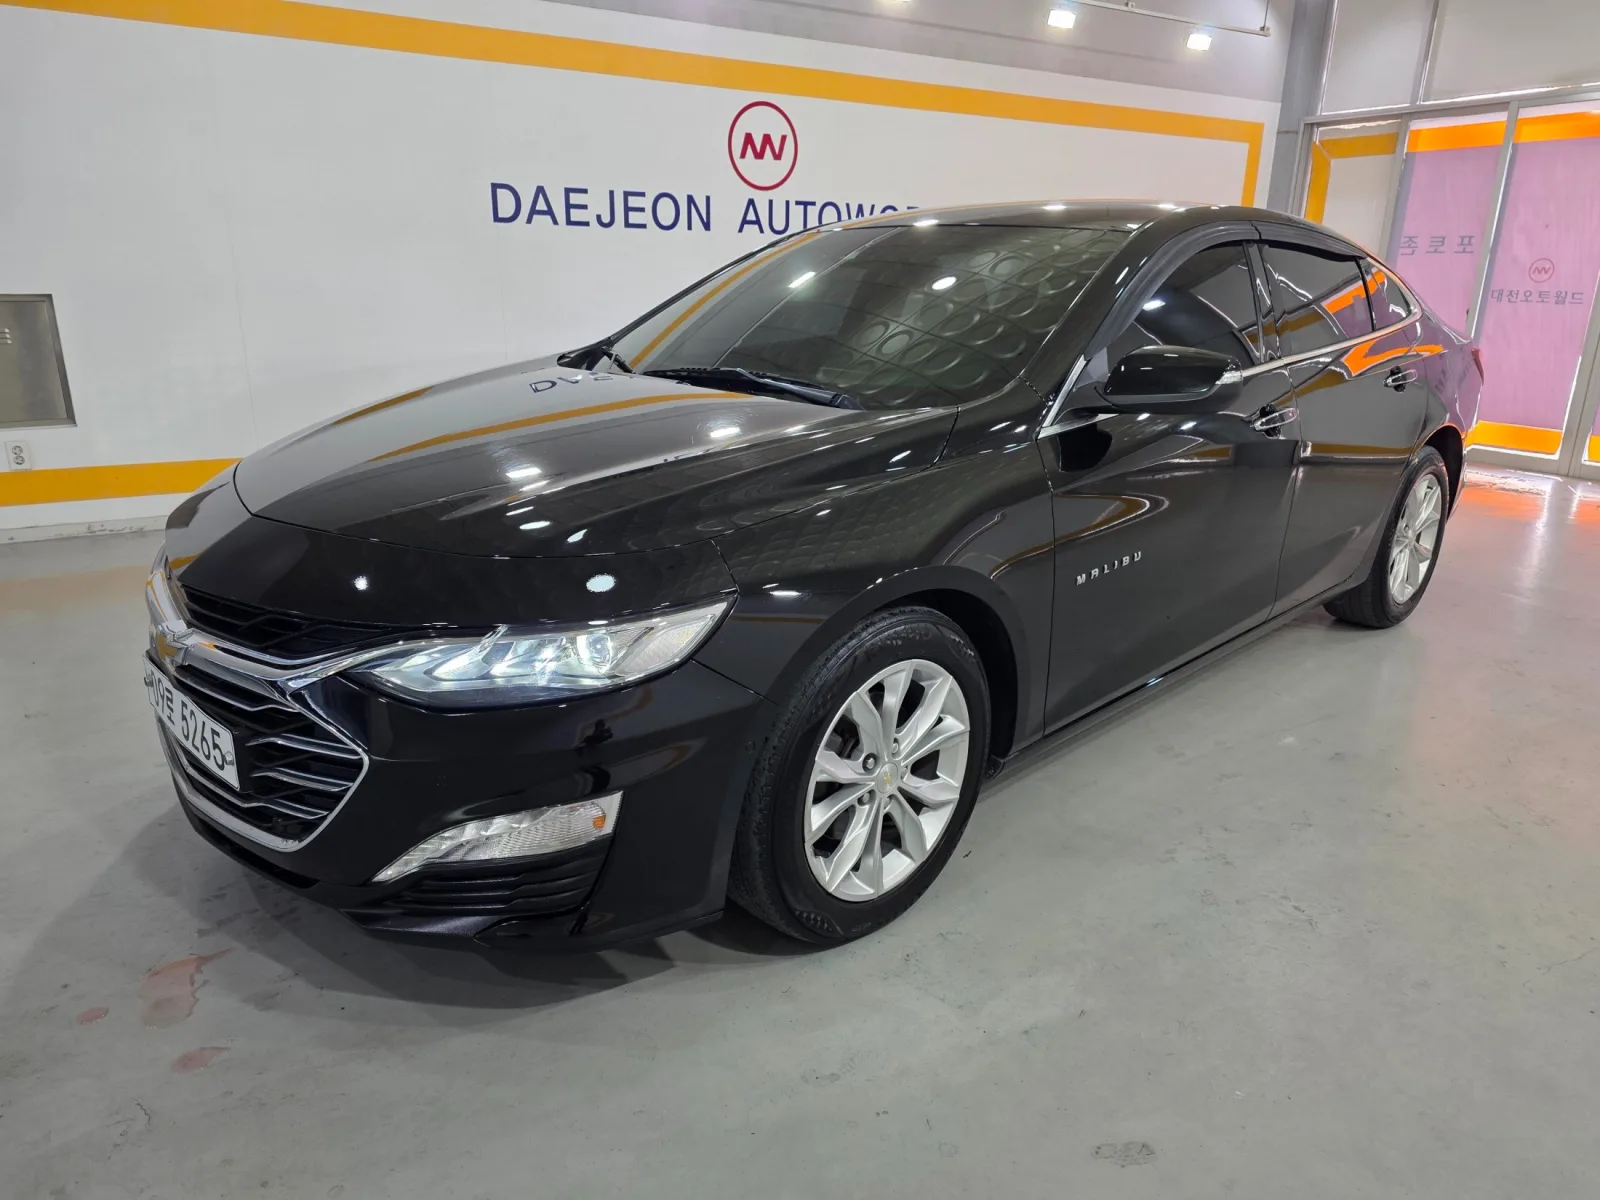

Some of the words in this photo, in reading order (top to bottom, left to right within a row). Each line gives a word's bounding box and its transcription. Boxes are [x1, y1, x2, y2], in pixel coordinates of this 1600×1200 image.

[490, 181, 711, 232] DAEJEON
[738, 197, 920, 236] AUTO
[1490, 288, 1585, 306] 대전오토월드
[1076, 550, 1142, 586] MALIBU
[180, 698, 226, 771] 5265
